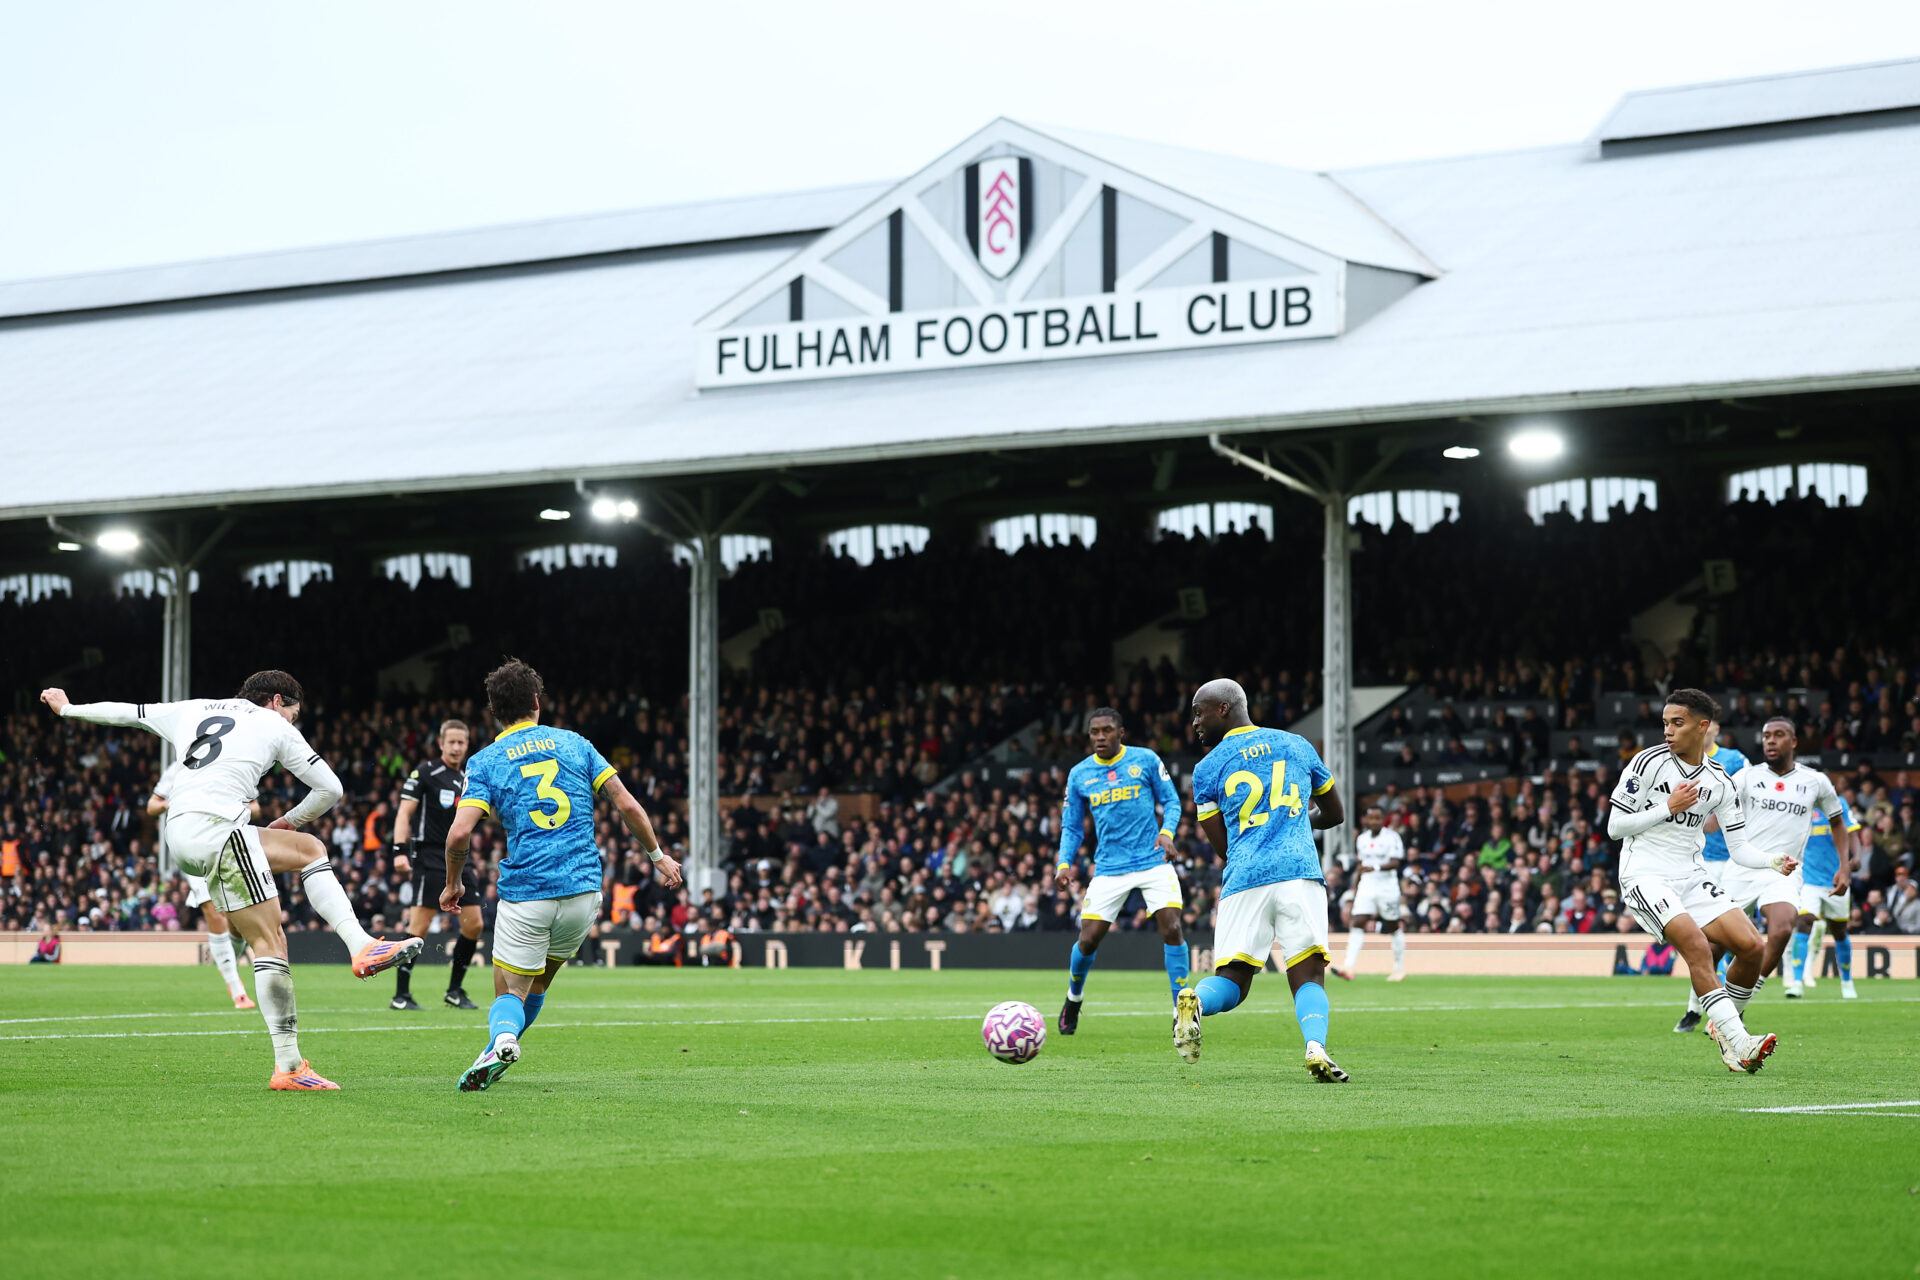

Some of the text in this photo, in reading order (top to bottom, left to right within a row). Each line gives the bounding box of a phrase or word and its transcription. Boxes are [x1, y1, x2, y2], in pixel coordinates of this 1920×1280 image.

[717, 286, 1313, 375] FULHAM FOOTBALL CLUB
[183, 716, 235, 770] 8
[506, 739, 556, 761] BUENO
[1240, 743, 1272, 761] TOTI
[519, 758, 571, 830] 3
[1089, 784, 1142, 807] DEBET
[1224, 759, 1304, 835] 24
[1761, 798, 1808, 817] SBOTOP
[844, 939, 947, 970] KIT
